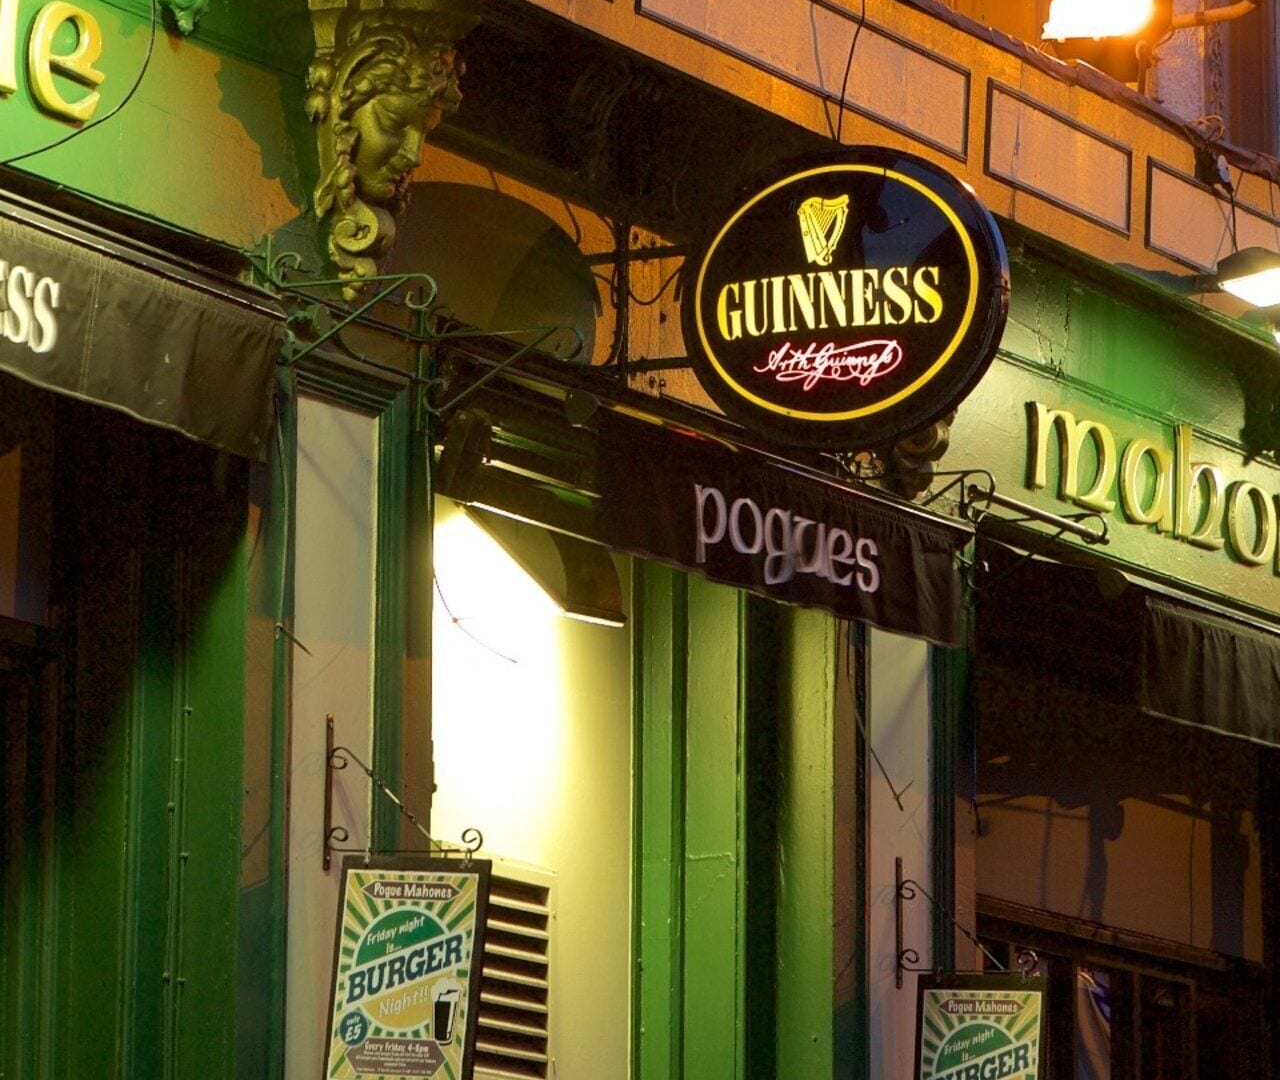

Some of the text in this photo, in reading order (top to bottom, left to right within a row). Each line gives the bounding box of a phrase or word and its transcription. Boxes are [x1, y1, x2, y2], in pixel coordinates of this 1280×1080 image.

[717, 265, 944, 341] GUINNESS
[694, 483, 880, 594] pogues
[373, 883, 452, 898] Pogue Mahones
[367, 916, 426, 946] Friday night
[346, 933, 464, 1004] BURGER
[379, 984, 430, 1017] Night!!
[948, 1000, 1019, 1014] Pogue Mahones
[345, 1023, 362, 1042] £5
[365, 1041, 383, 1052] Every
[944, 1028, 995, 1056] Friday night
